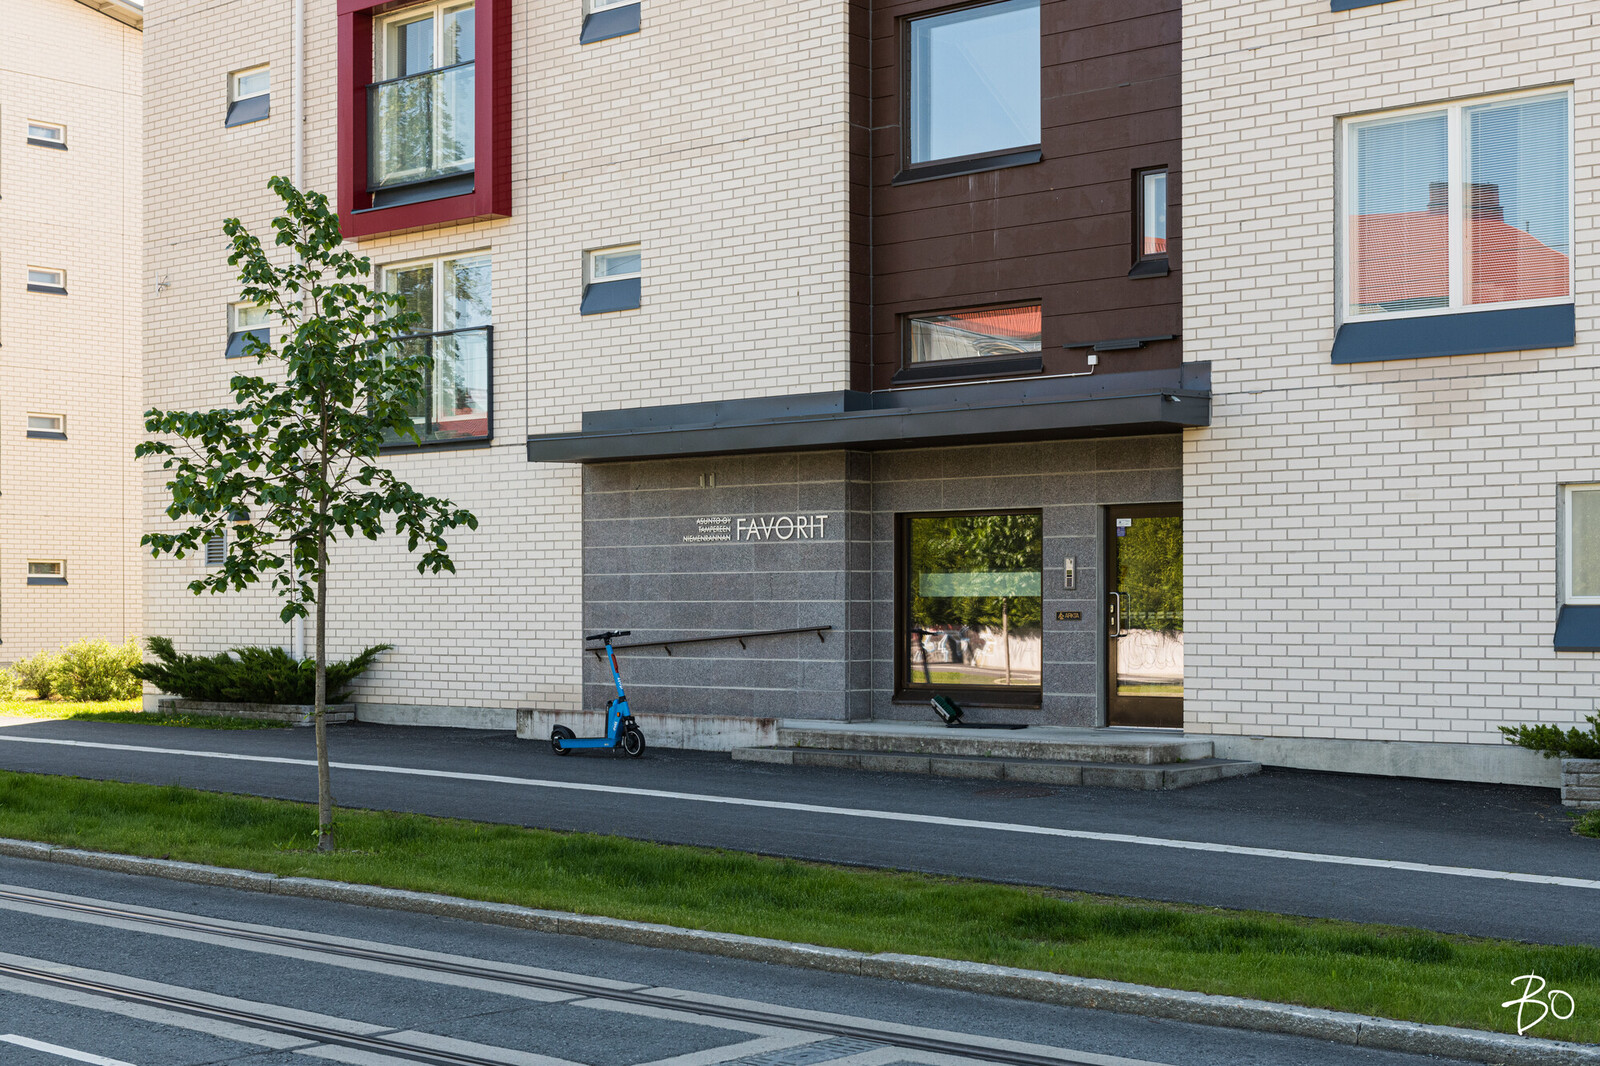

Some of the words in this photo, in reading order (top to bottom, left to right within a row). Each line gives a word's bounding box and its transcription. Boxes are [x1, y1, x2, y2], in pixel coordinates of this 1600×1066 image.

[698, 525, 731, 533] TAMPEREEN
[737, 515, 828, 540] FAVORIT
[683, 534, 731, 542] NIEMENRANNAN
